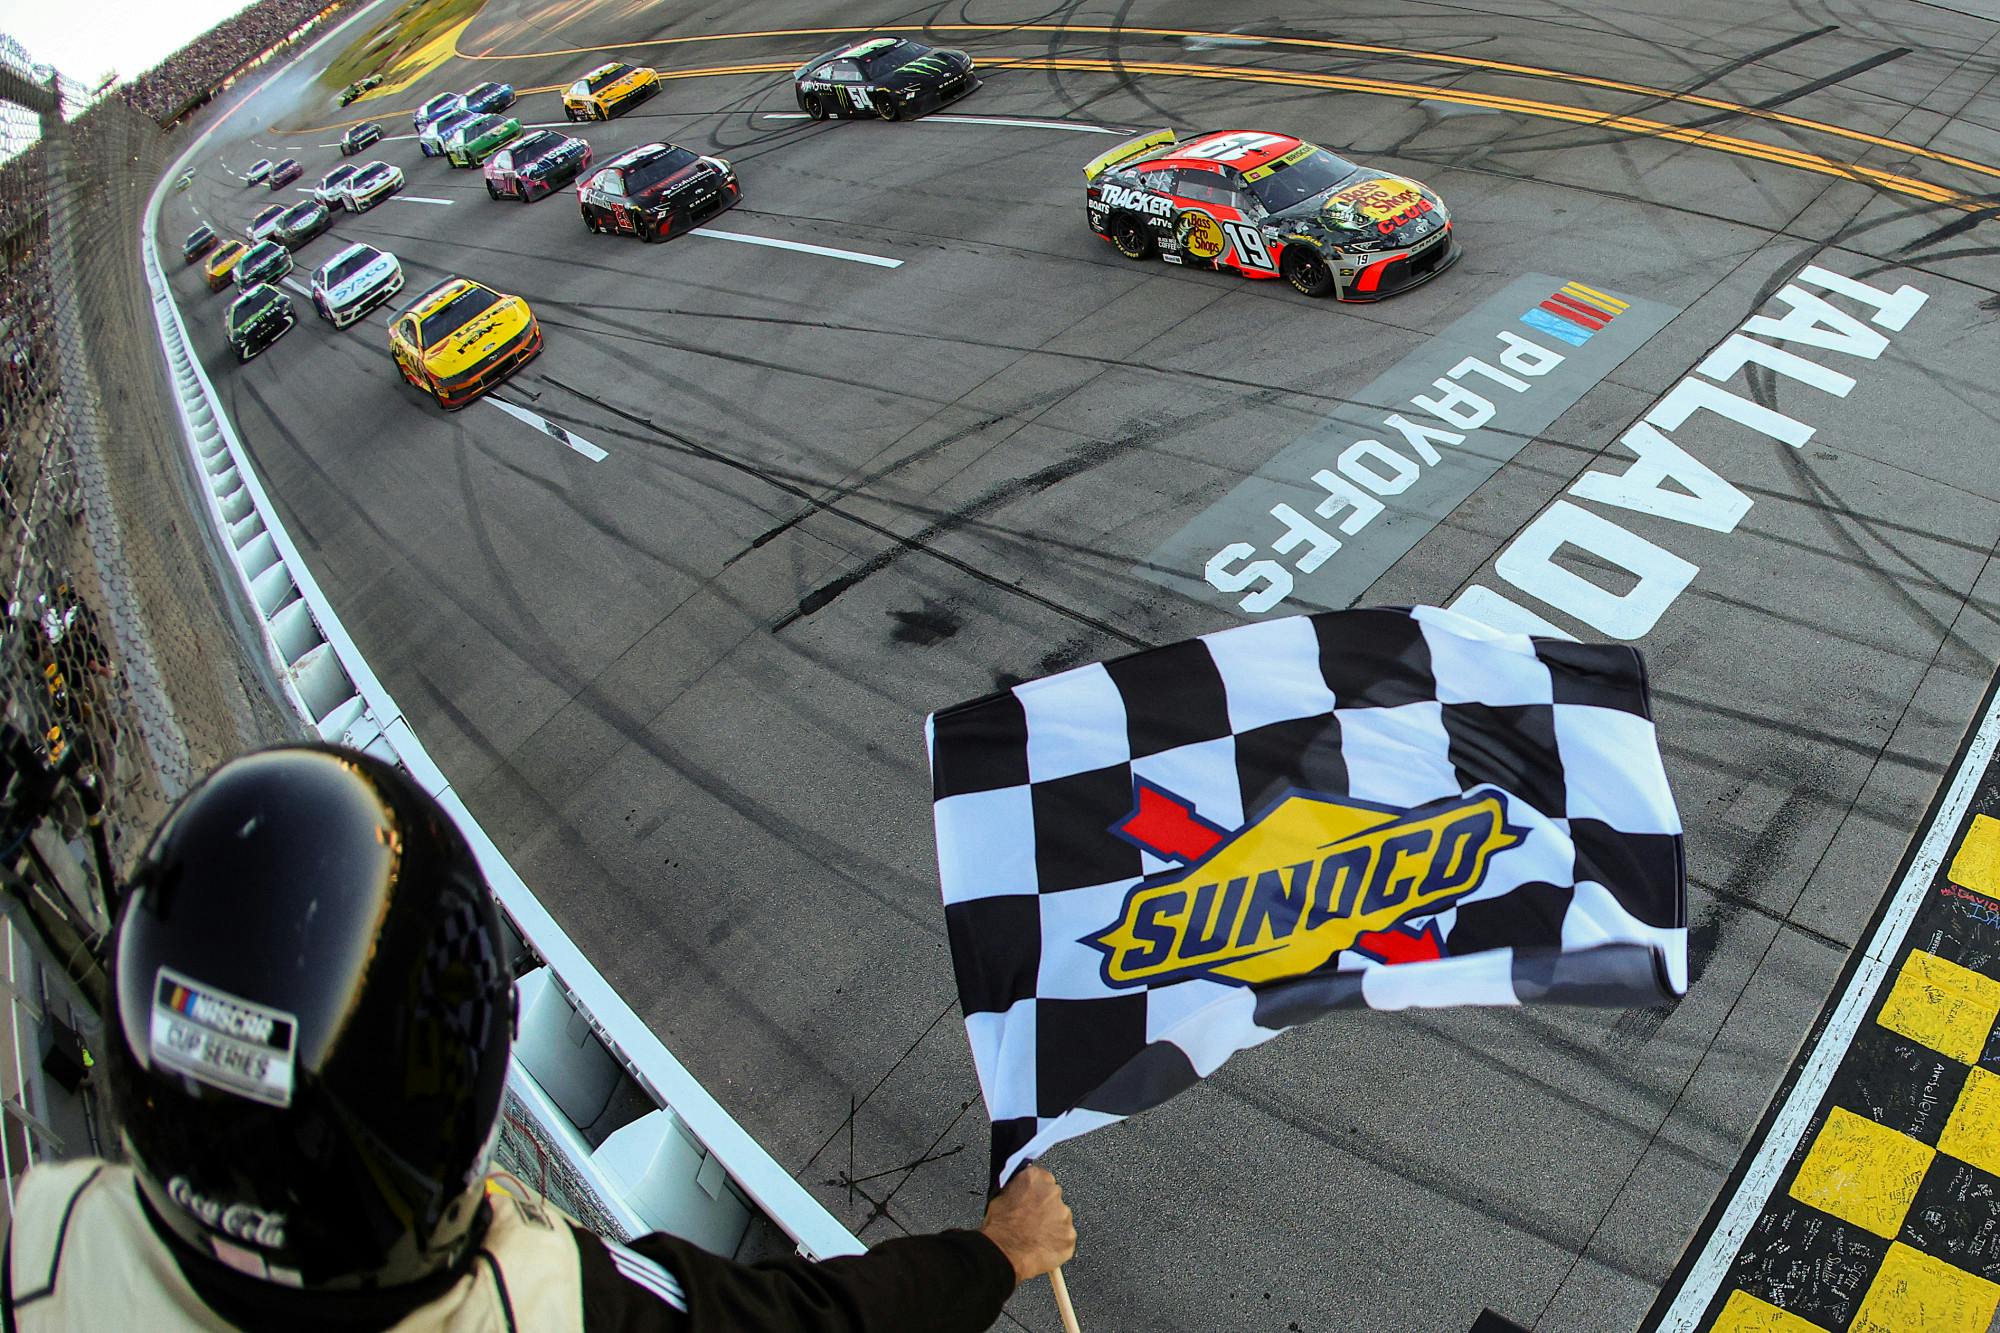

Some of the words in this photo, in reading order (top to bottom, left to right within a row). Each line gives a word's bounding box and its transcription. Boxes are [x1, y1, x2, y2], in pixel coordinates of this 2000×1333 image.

[846, 86, 875, 110] 54
[1100, 183, 1175, 218] TRACKER
[1336, 181, 1381, 203] Bass
[1359, 190, 1389, 208] Pro
[1370, 188, 1421, 214] Shops
[1088, 198, 1111, 214] BOATS
[1376, 198, 1434, 235] CLUB
[1147, 217, 1173, 229] ATVs
[1190, 213, 1211, 230] Bass
[1194, 227, 1209, 240] Pro
[1194, 236, 1220, 255] Shops
[1223, 221, 1274, 270] 19
[1356, 254, 1369, 266] 19
[1205, 331, 1566, 614] PLAYOFFS
[1119, 811, 1496, 972] SUNOCO
[194, 995, 274, 1045] NASCAR
[167, 1021, 201, 1051] CUP
[204, 1041, 270, 1081] SERIES
